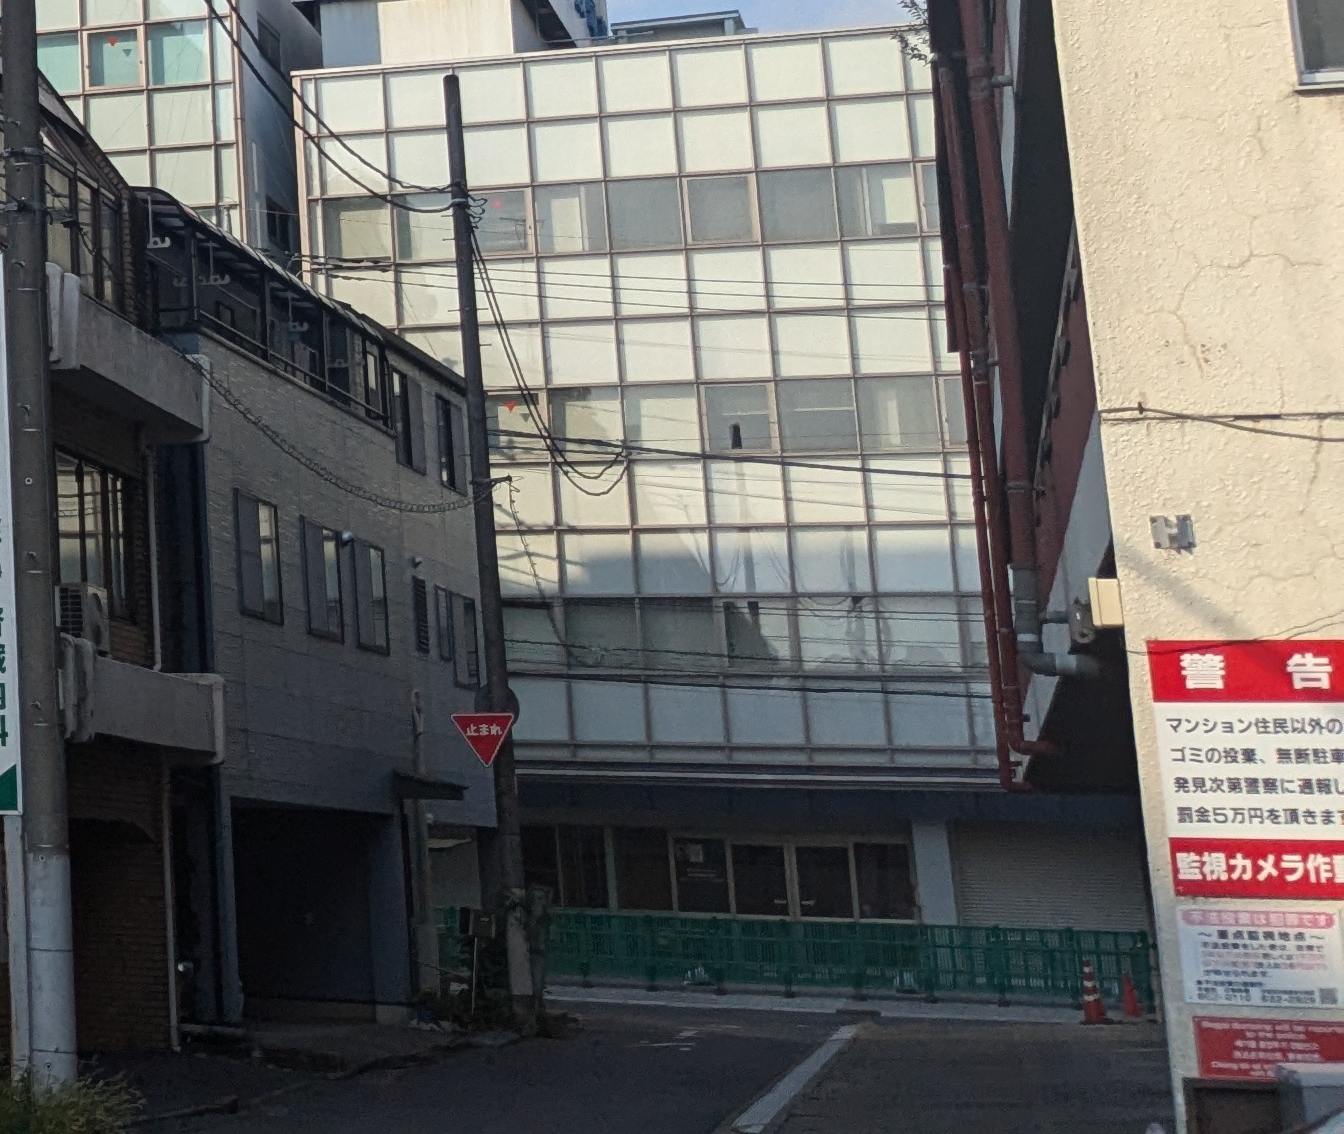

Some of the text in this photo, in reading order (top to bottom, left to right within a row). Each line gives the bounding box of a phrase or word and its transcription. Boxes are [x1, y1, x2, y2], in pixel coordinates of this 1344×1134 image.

[466, 723, 502, 736] 止まれ
[1166, 717, 1344, 735] マンション住民以外の
